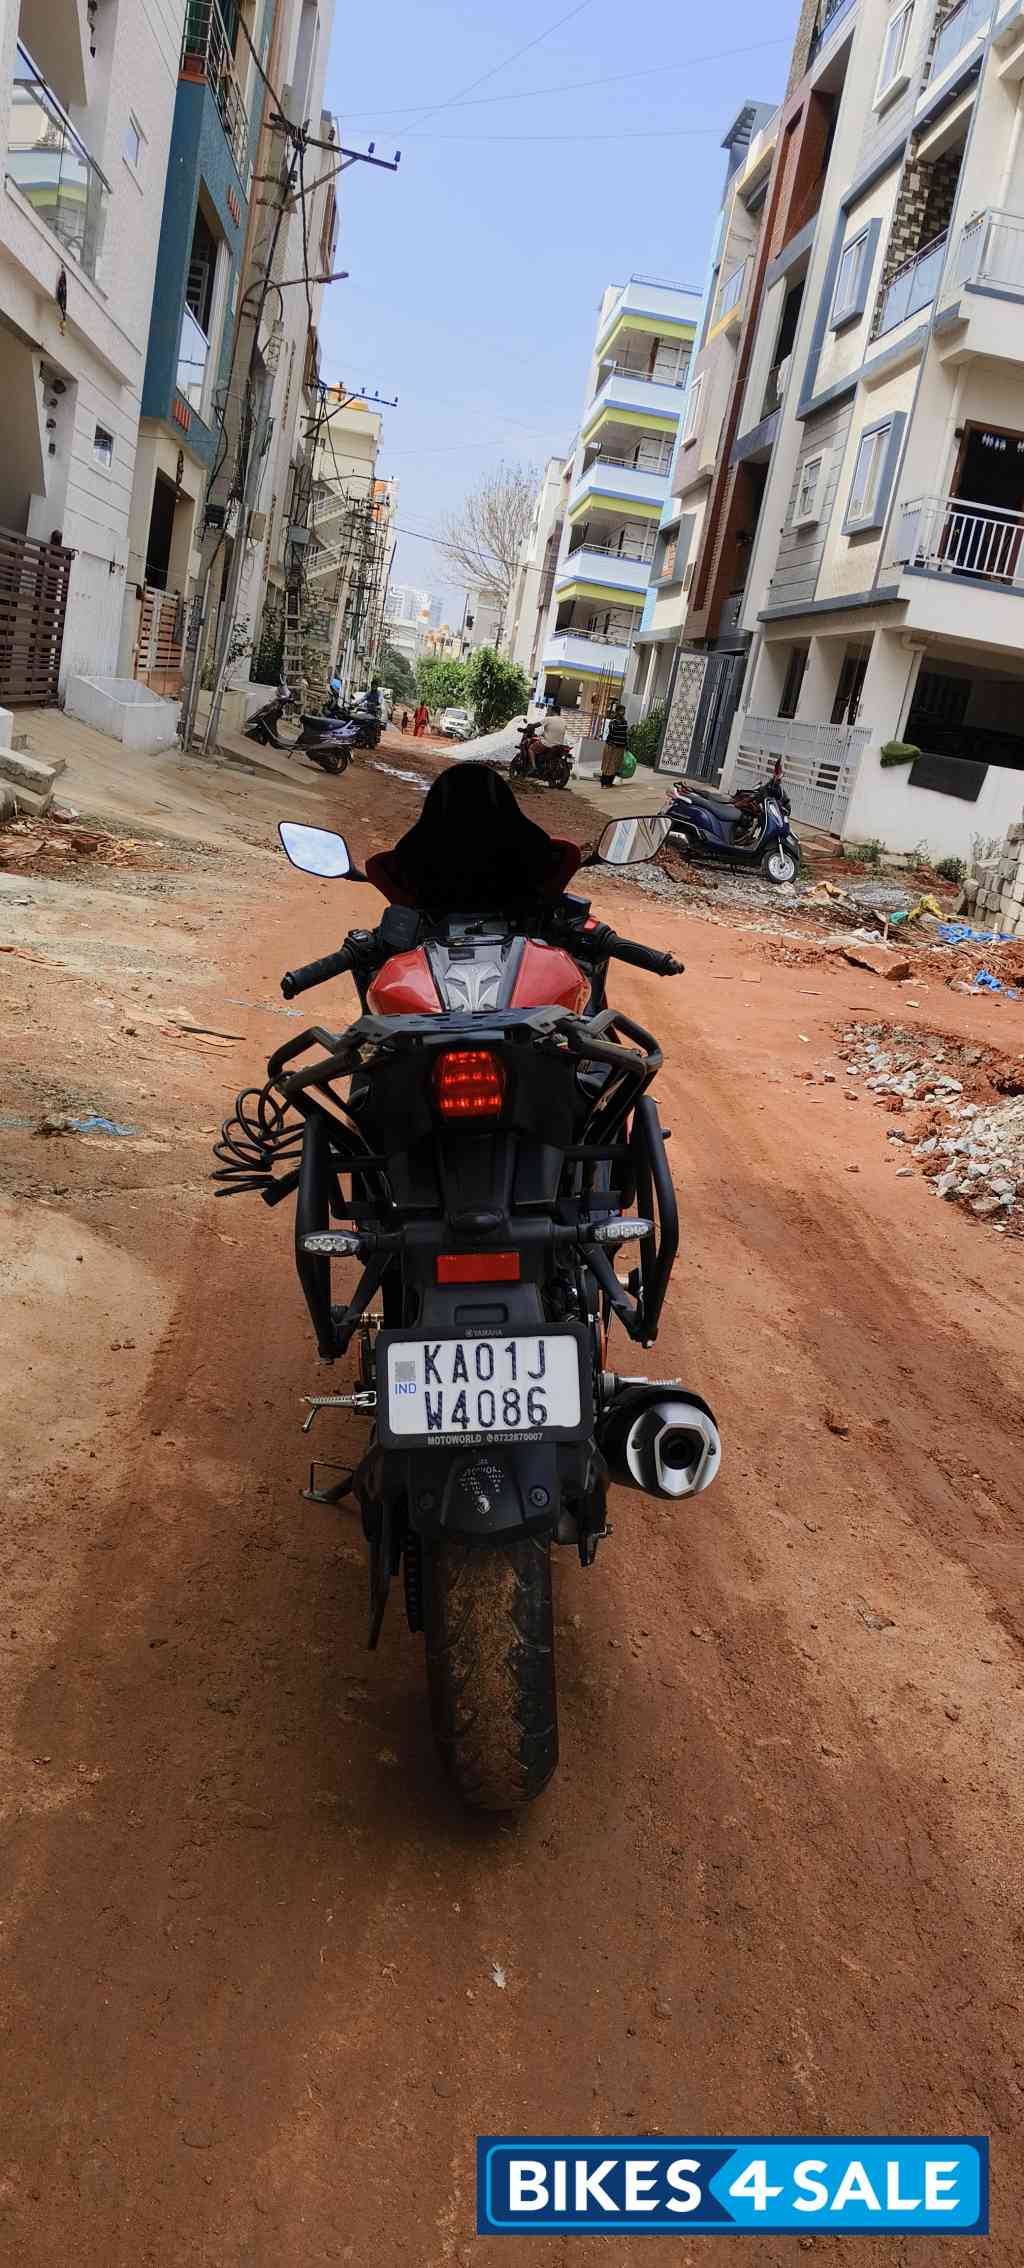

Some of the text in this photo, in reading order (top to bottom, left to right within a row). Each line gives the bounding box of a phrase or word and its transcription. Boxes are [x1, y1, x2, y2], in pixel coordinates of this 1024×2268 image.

[423, 1340, 546, 1385] KA01J
[395, 1382, 417, 1395] IND
[424, 1386, 548, 1431] W4086
[427, 1434, 482, 1446] MOTOWORLD
